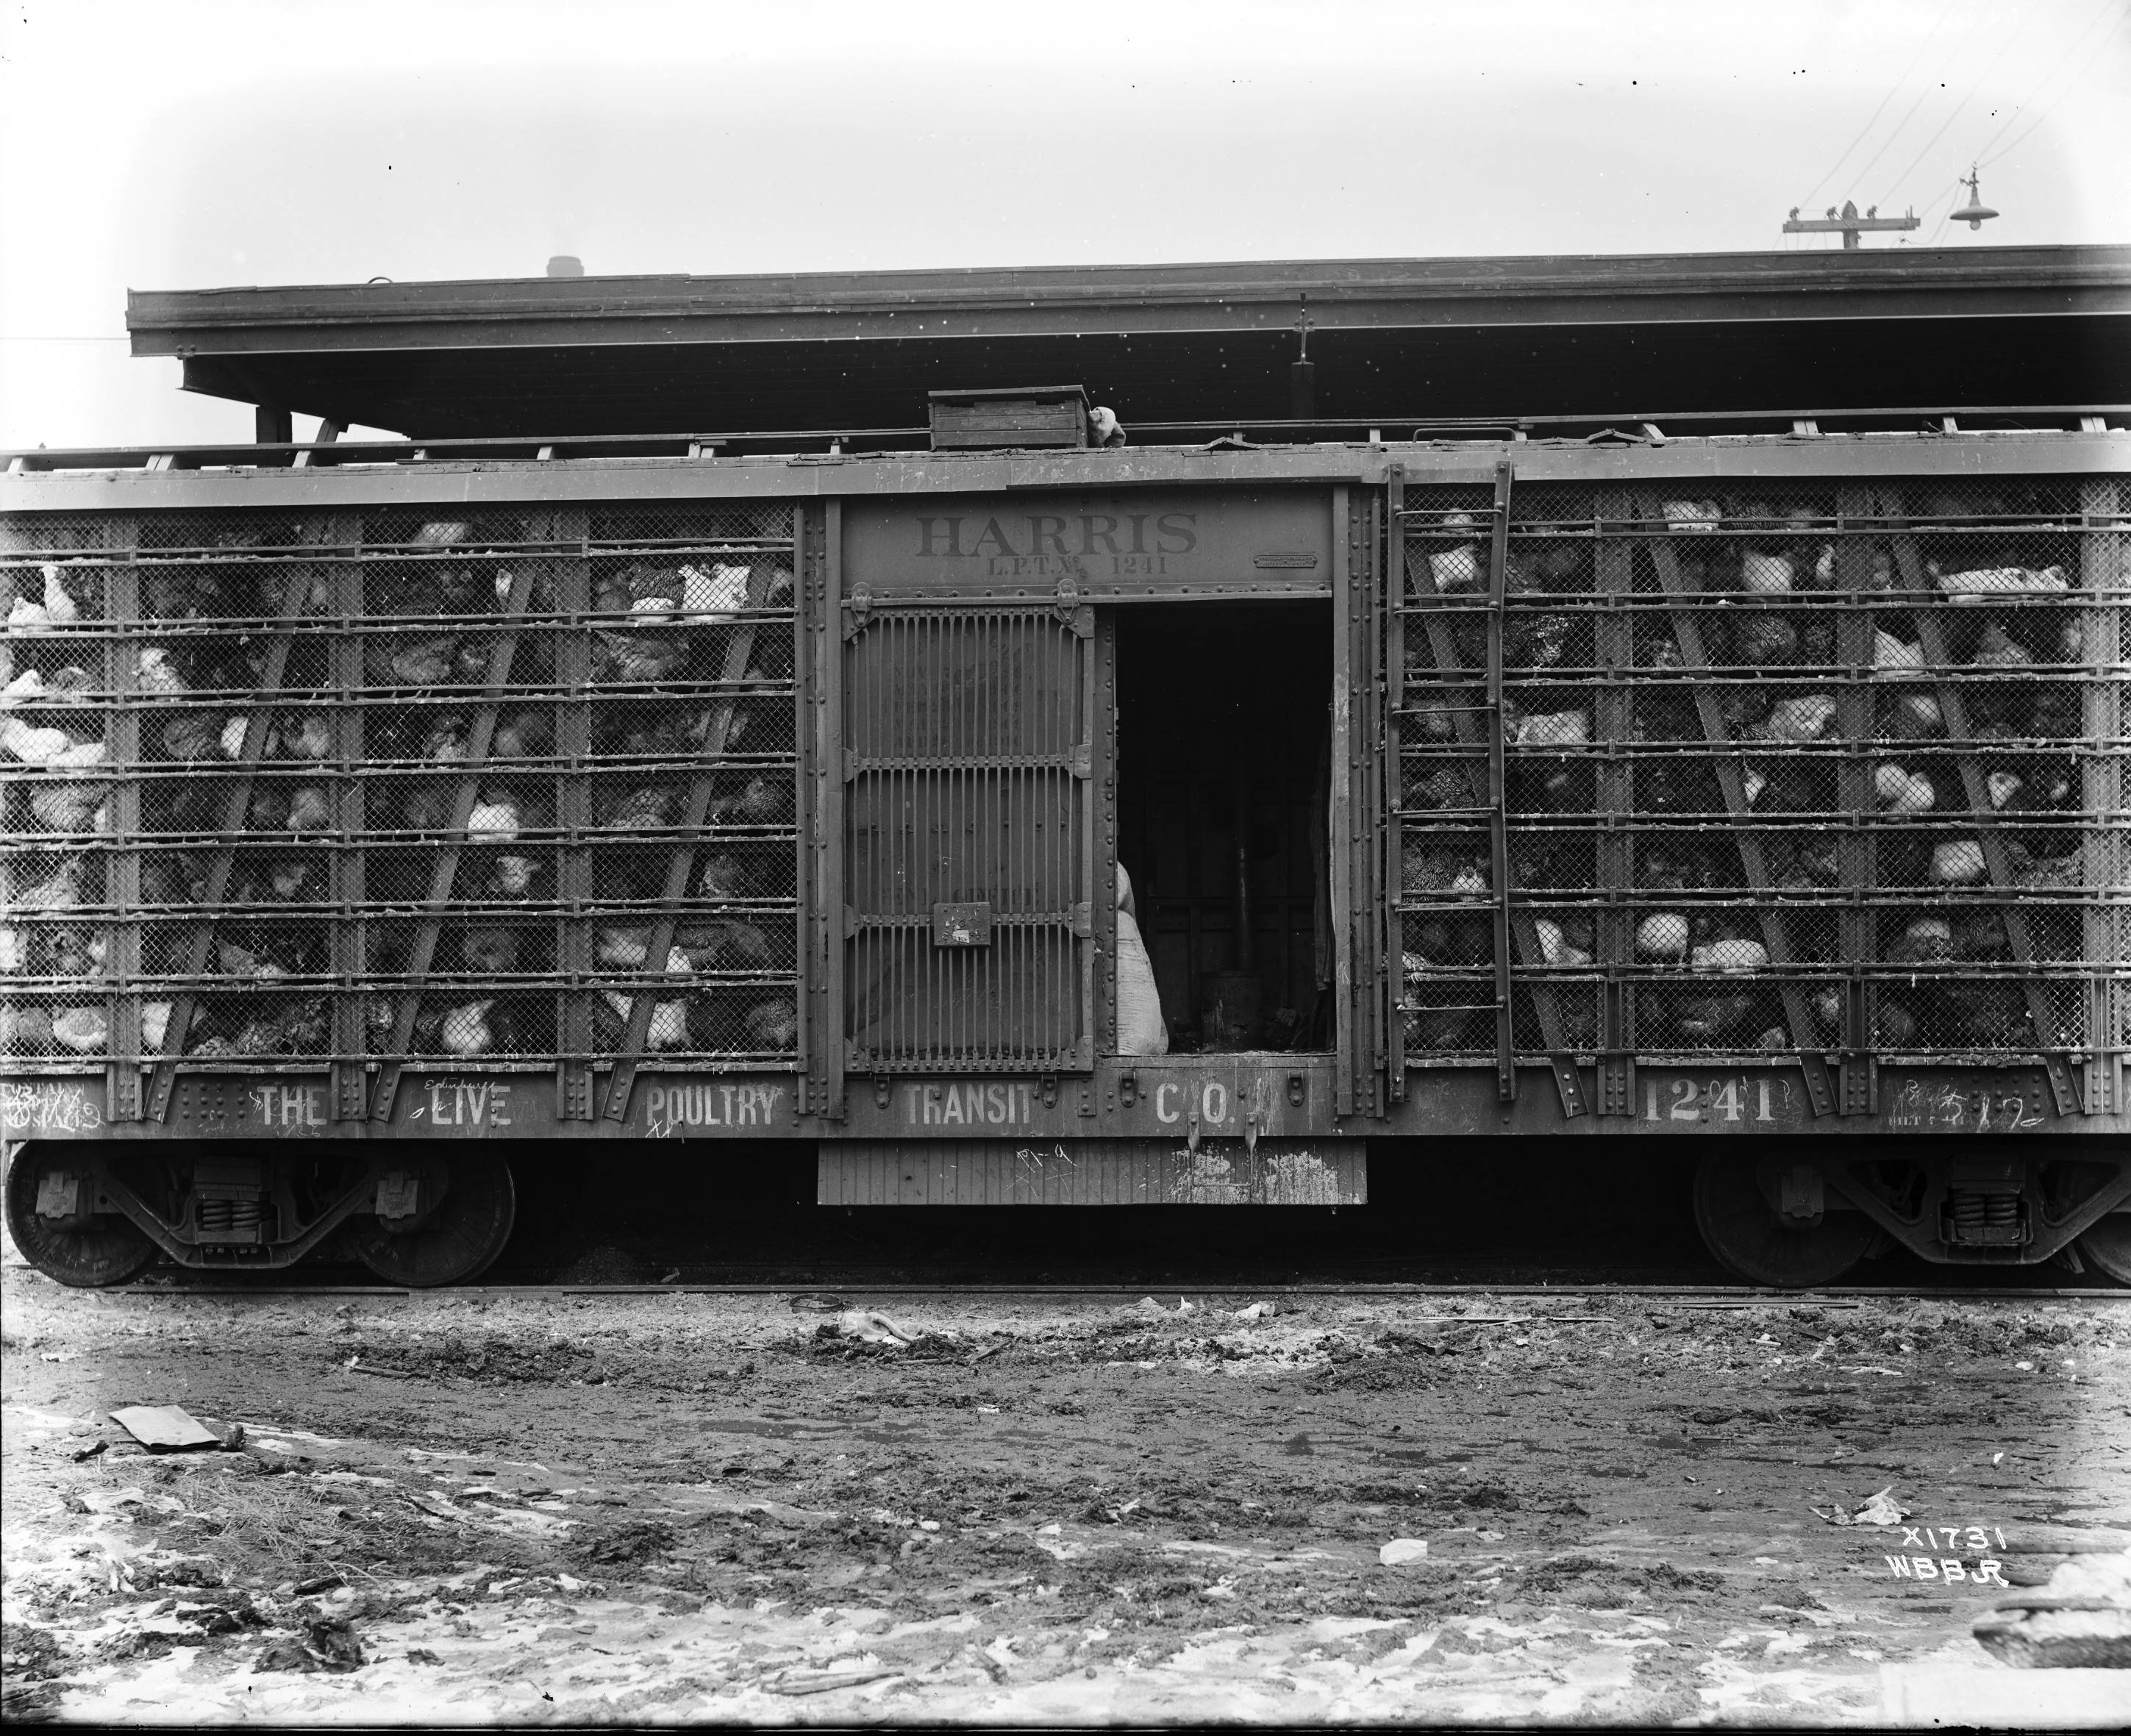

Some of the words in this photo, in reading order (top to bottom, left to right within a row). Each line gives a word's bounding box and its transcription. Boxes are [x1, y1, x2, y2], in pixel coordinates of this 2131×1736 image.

[915, 512, 1197, 557] HARRIS
[1111, 556, 1167, 575] 1241
[257, 1085, 327, 1124] THE
[432, 1085, 512, 1125] LIVE
[646, 1085, 779, 1126] POULTRY
[903, 1082, 1035, 1124] TRANSIT
[1643, 1079, 1776, 1121] 1241
